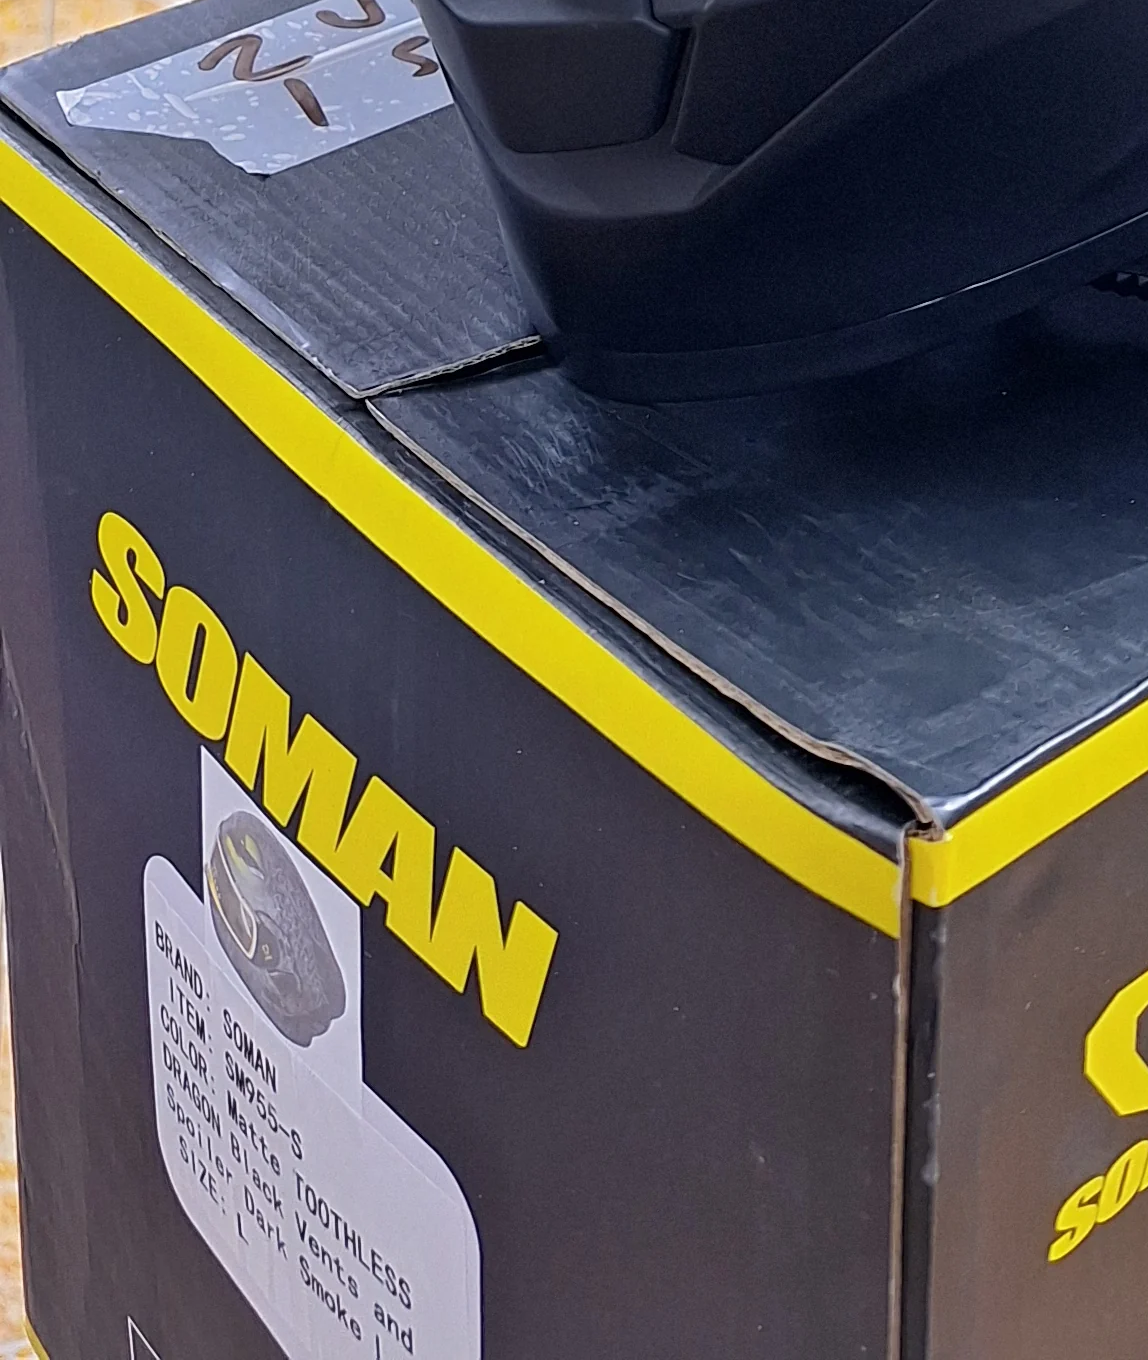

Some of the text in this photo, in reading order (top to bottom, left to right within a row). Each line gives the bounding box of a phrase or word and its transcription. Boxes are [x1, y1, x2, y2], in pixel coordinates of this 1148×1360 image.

[91, 511, 560, 1049] SOMAN
[155, 920, 277, 1095] BRAND: SOMAN
[170, 977, 303, 1161] ITEM: SM955-S
[160, 1003, 412, 1311] COLOR: Matte TOOTHLESS
[163, 1041, 414, 1356] DRAGON Black Vents and
[167, 1083, 362, 1342] Spoiler Dark Smoke
[179, 1135, 250, 1246] SIZE: L
